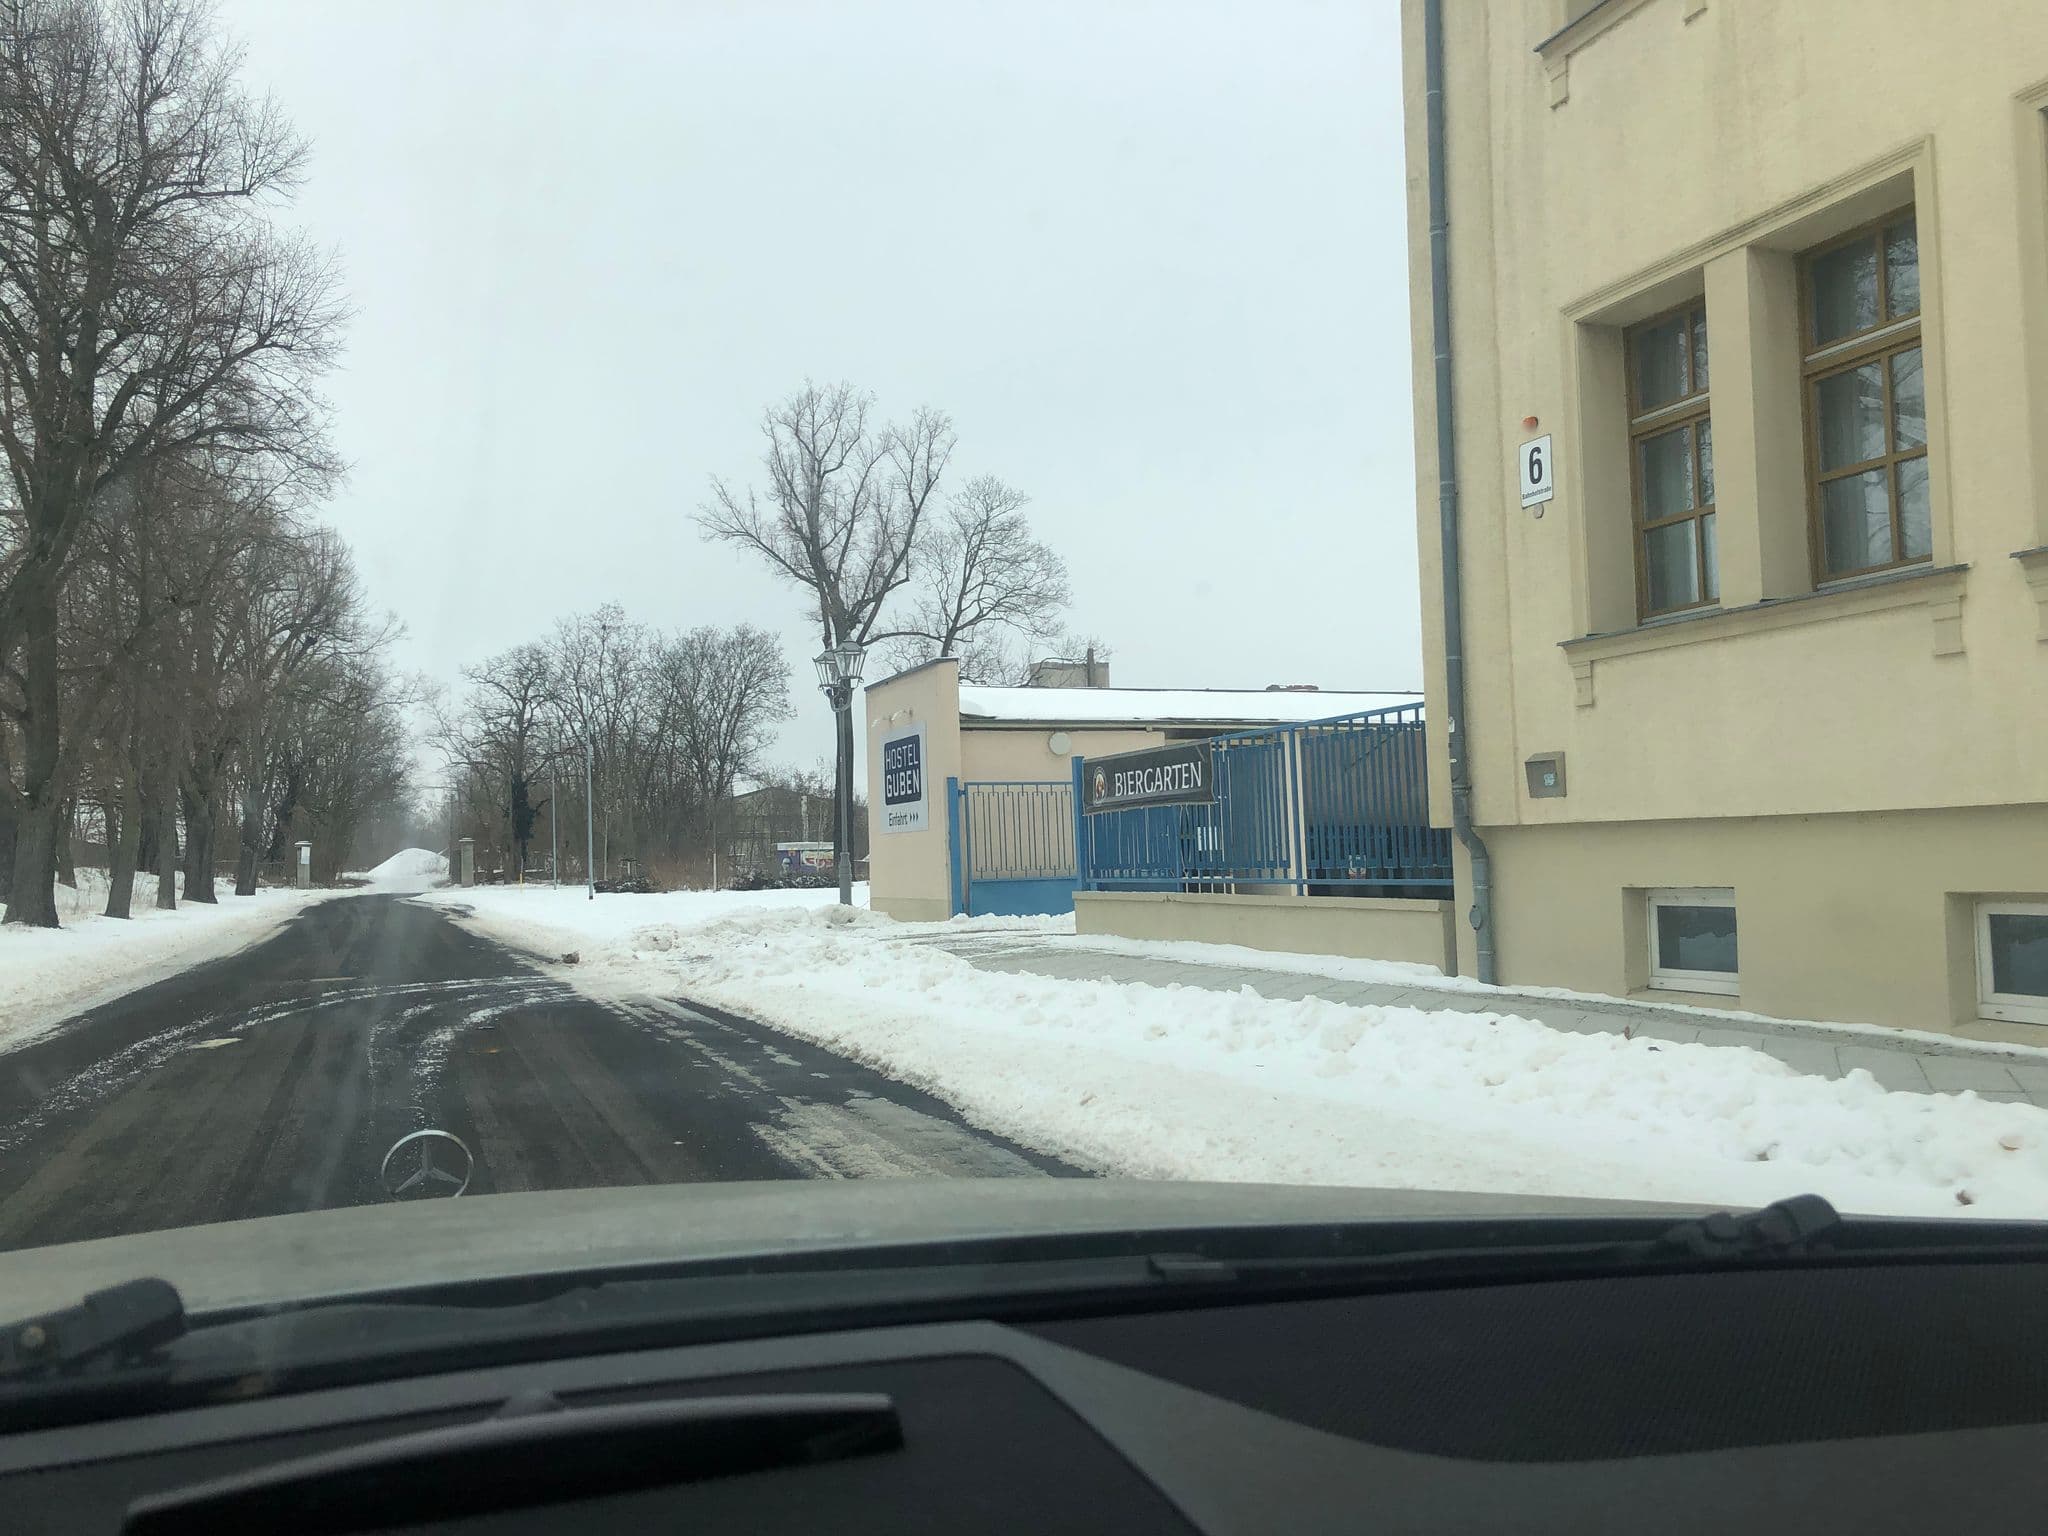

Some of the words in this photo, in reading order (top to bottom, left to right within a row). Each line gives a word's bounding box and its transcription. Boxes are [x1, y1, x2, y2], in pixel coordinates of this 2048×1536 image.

[1529, 446, 1543, 485] 6
[886, 743, 919, 770] HOSTEL
[886, 769, 920, 797] GUBEN
[1114, 761, 1201, 797] BIERGARTEN
